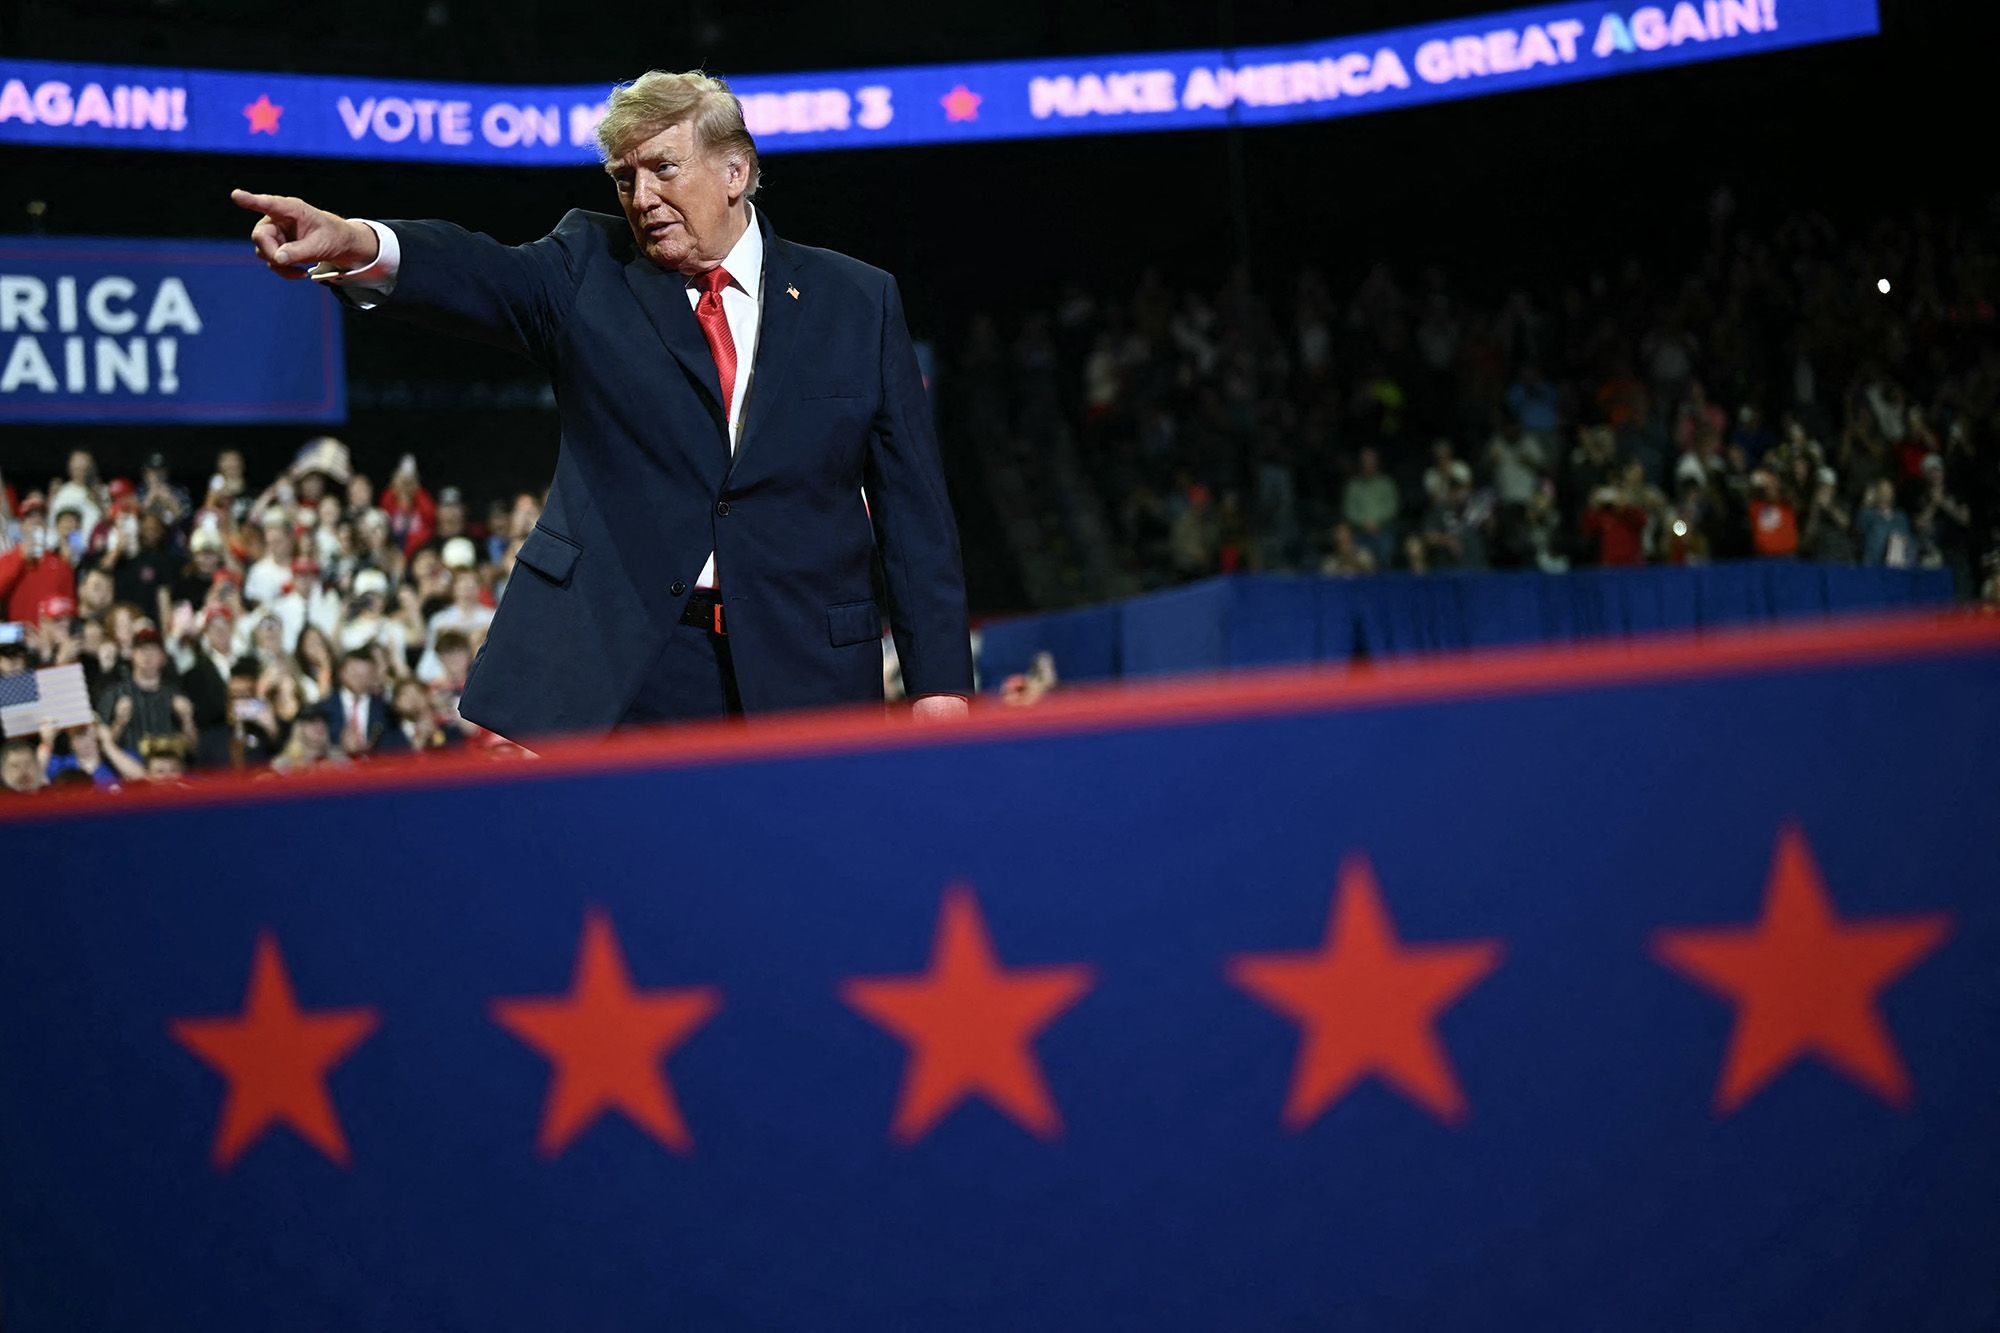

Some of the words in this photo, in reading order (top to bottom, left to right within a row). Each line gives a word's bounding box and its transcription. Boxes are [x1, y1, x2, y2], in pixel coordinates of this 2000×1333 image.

[1029, 70, 1177, 119] MAKE
[1182, 47, 1411, 110] AMERICA
[1414, 18, 1584, 84] GREAT
[1593, 0, 1778, 58] AGAIN!
[0, 78, 188, 131] AGAIN!
[336, 95, 474, 146] VOTE
[482, 101, 561, 149] ON
[855, 85, 894, 130] 3
